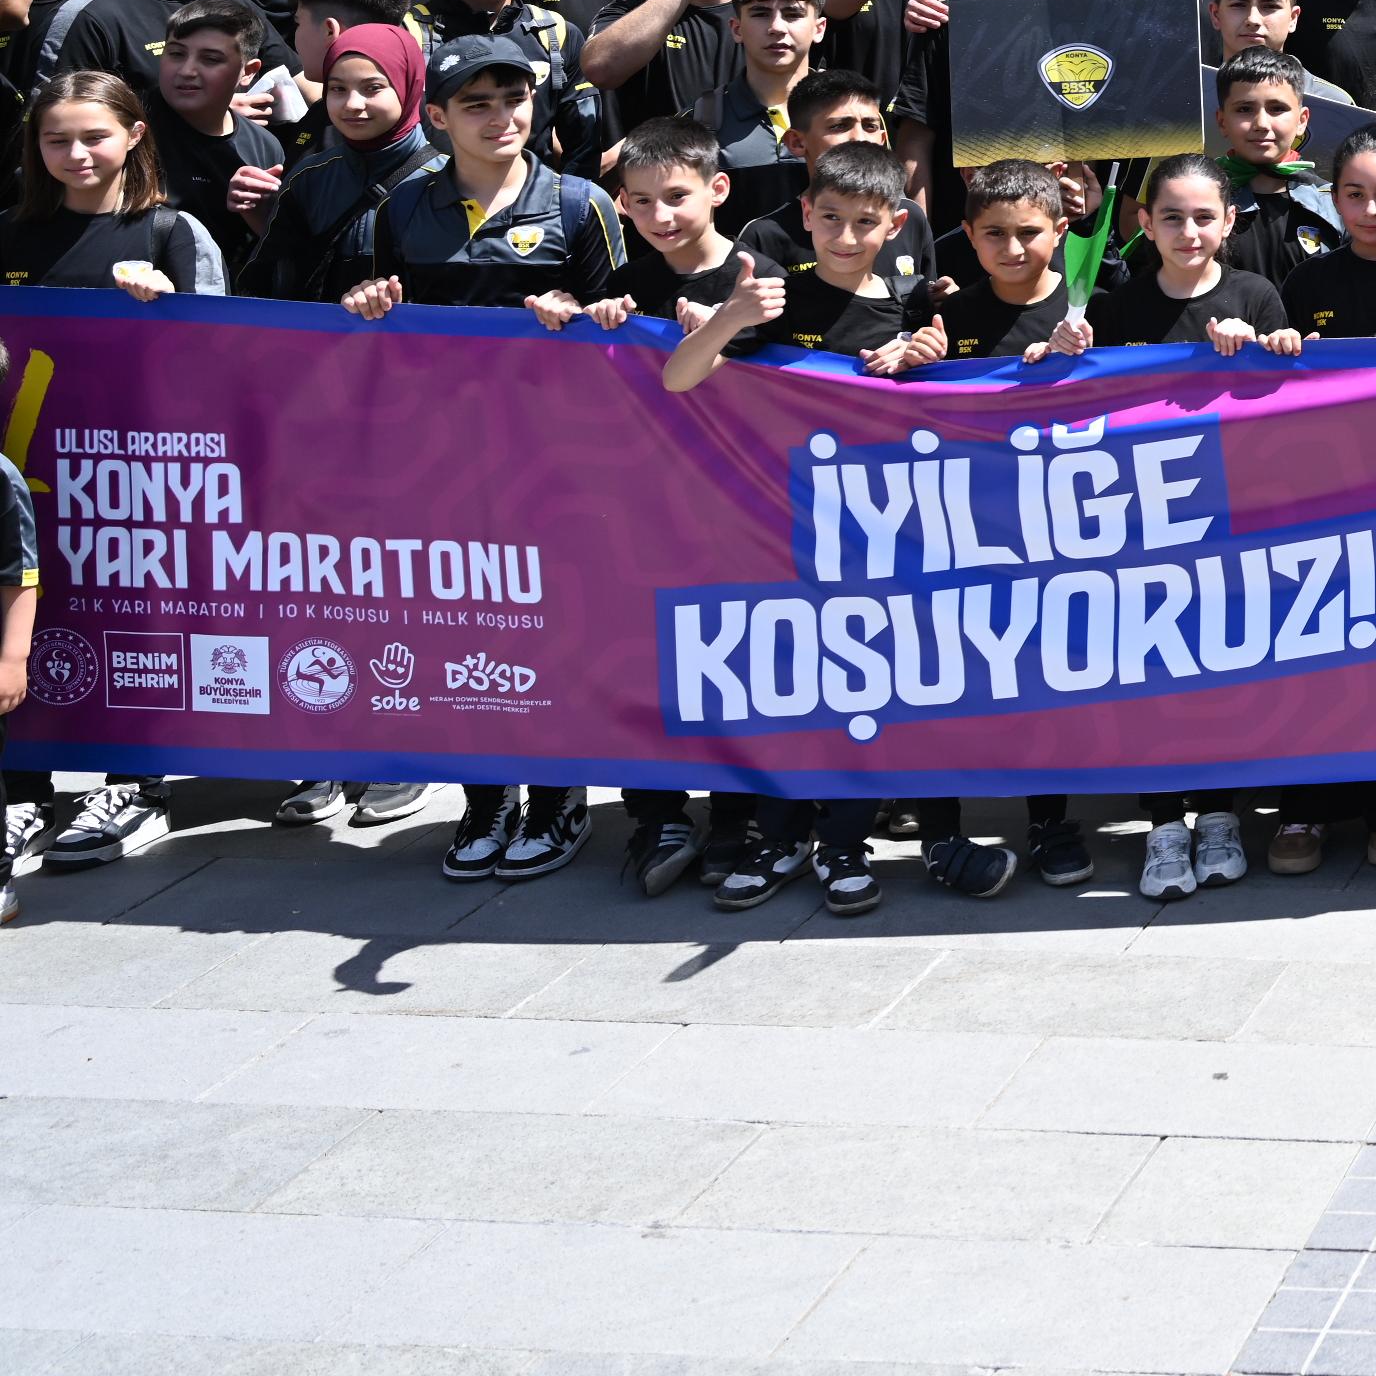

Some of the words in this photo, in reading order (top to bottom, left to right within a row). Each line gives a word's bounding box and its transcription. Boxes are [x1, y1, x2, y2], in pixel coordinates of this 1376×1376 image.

[1061, 81, 1096, 94] BBSK
[958, 338, 980, 346] ONYA
[55, 428, 227, 458] ULUSLARARASI
[56, 458, 243, 524] KONYA
[809, 414, 1216, 581] İYİLİĞE
[57, 525, 189, 589] YARI
[212, 530, 543, 604] MARATONU
[69, 597, 86, 612] 21
[93, 599, 104, 613] K
[111, 599, 151, 615] YARI
[160, 600, 245, 618] MARATON
[278, 604, 298, 619] 10
[306, 604, 316, 619] K
[324, 605, 390, 624] KOŞUSU
[422, 610, 469, 626] HALK
[476, 612, 545, 630] KOŞUSU
[214, 677, 246, 687] KONYA
[199, 684, 262, 699] BÜYÜKŞEHİR
[211, 696, 250, 706] BELEDİYESİ
[371, 689, 421, 712] sobe
[480, 697, 519, 705] SENDROMLU
[519, 698, 552, 706] BİREYLER
[502, 706, 530, 714] MERKEZİ
